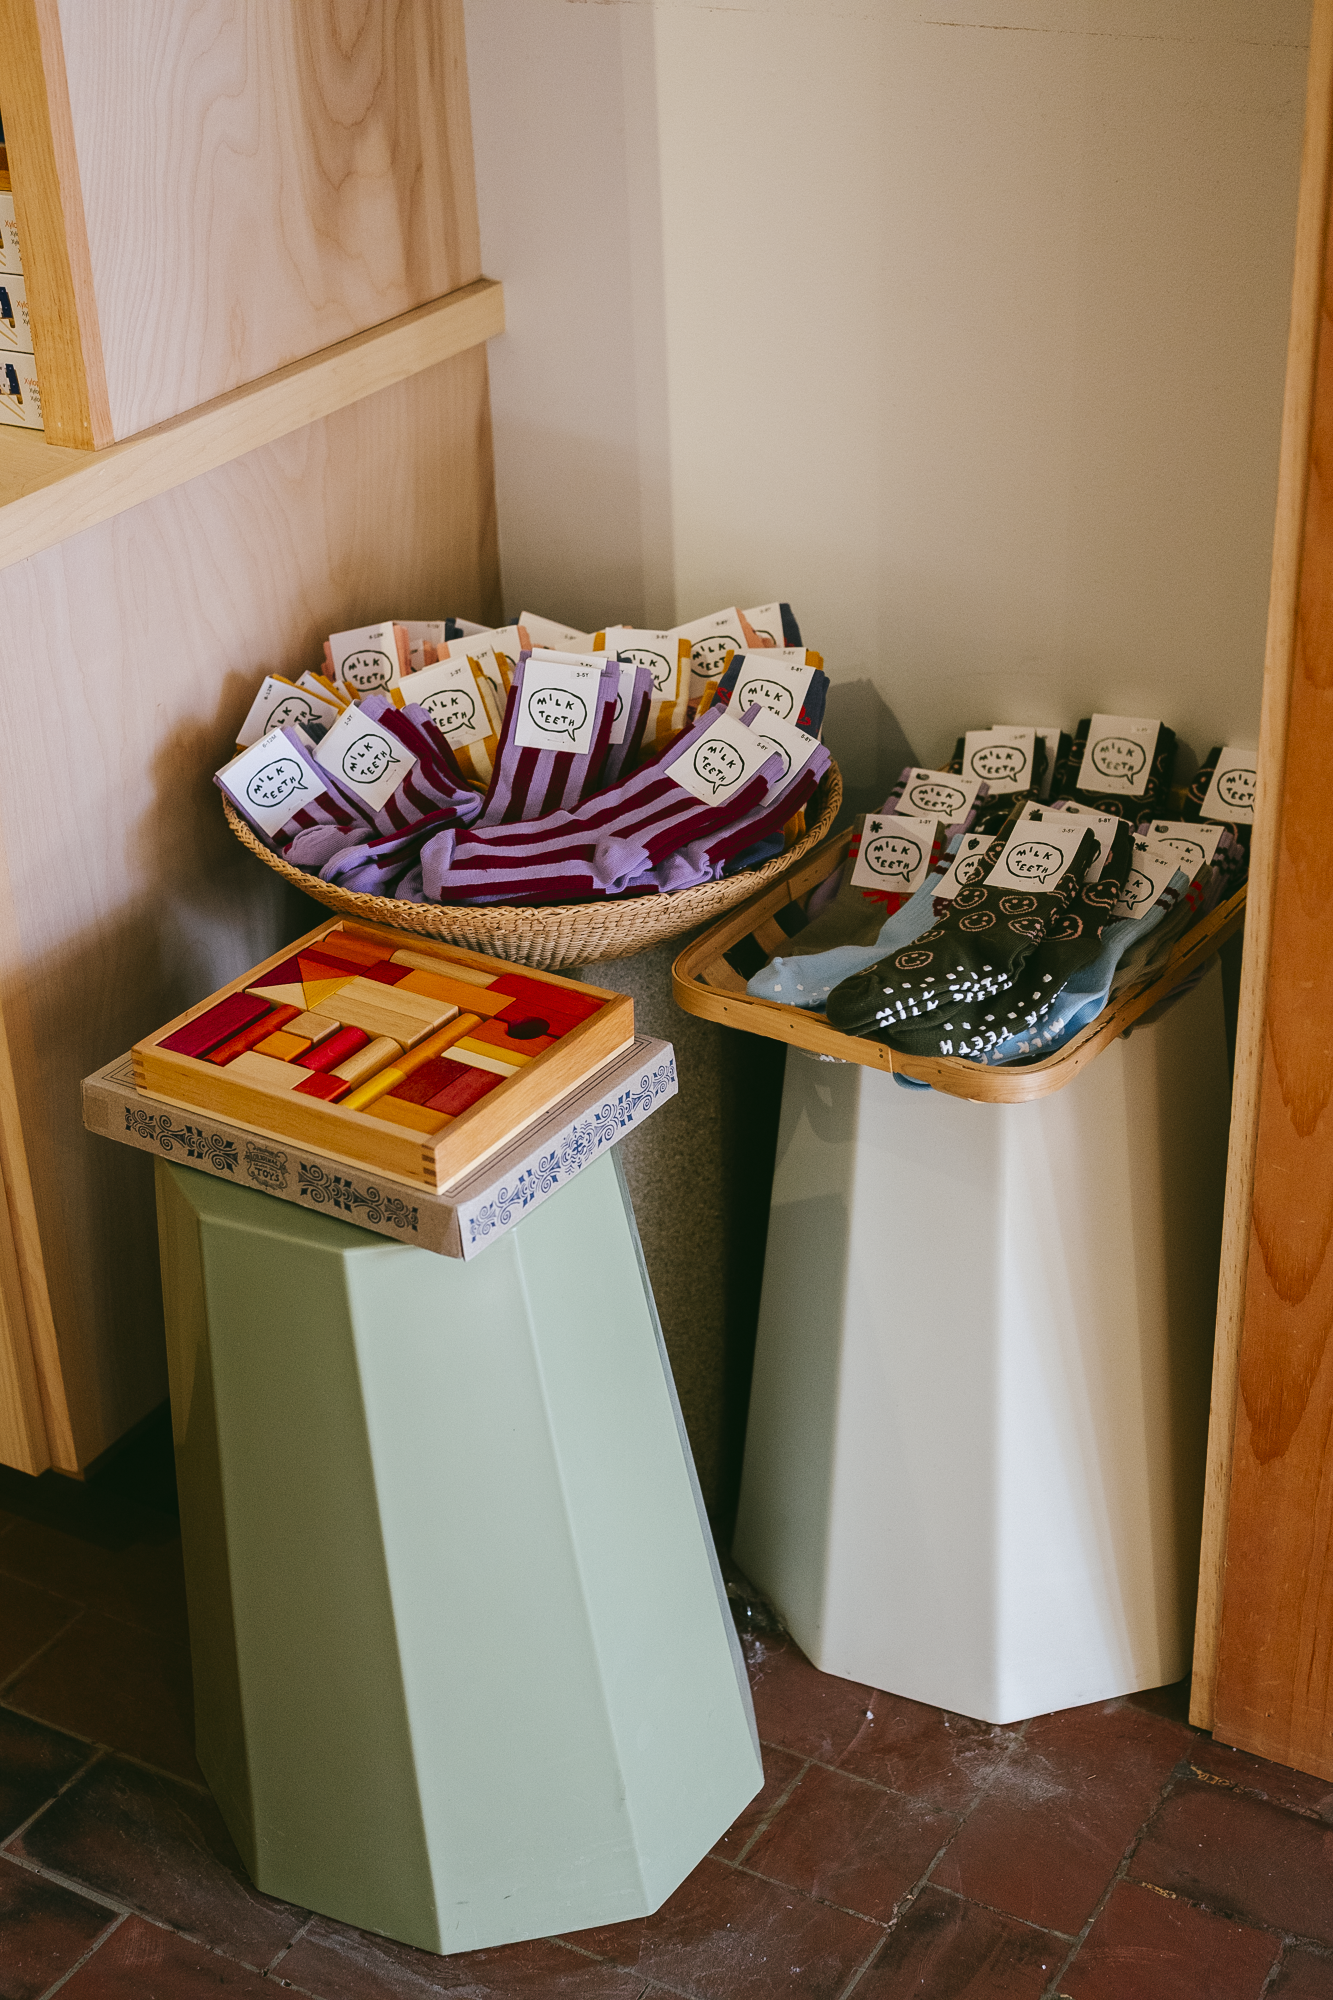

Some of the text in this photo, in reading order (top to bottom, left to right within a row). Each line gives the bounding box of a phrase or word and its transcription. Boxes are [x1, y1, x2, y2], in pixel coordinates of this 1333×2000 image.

[692, 643, 726, 660] MILK
[348, 657, 380, 672] MILK
[633, 654, 658, 667] ILK
[697, 656, 726, 671] TEET
[352, 673, 385, 685] TEETH
[747, 684, 783, 702] MILK
[427, 697, 459, 714] MILK
[536, 693, 575, 711] MILK
[747, 699, 780, 716] TTH
[270, 707, 292, 729] ILK
[432, 711, 467, 727] TEETH
[538, 710, 575, 727] TEETH
[800, 733, 812, 743] 5-8Y
[756, 742, 769, 751] 5-8Y
[1100, 742, 1135, 757] MILK
[349, 742, 373, 772] MILK
[360, 750, 388, 775] TEETH
[706, 746, 736, 769] MILK
[979, 750, 1014, 761] MILK
[702, 756, 727, 782] TEETH
[981, 764, 1016, 774] TEETH
[1101, 757, 1134, 772] TEETH
[254, 766, 285, 794] MILK
[262, 776, 296, 799] TEETH
[918, 787, 954, 799] MILK
[919, 797, 953, 809] TEETH
[873, 841, 911, 855] MILK
[1016, 846, 1053, 860] MILK
[874, 856, 910, 870] TEETH
[1015, 860, 1049, 874] TEETH
[254, 1167, 280, 1182] TOYS
